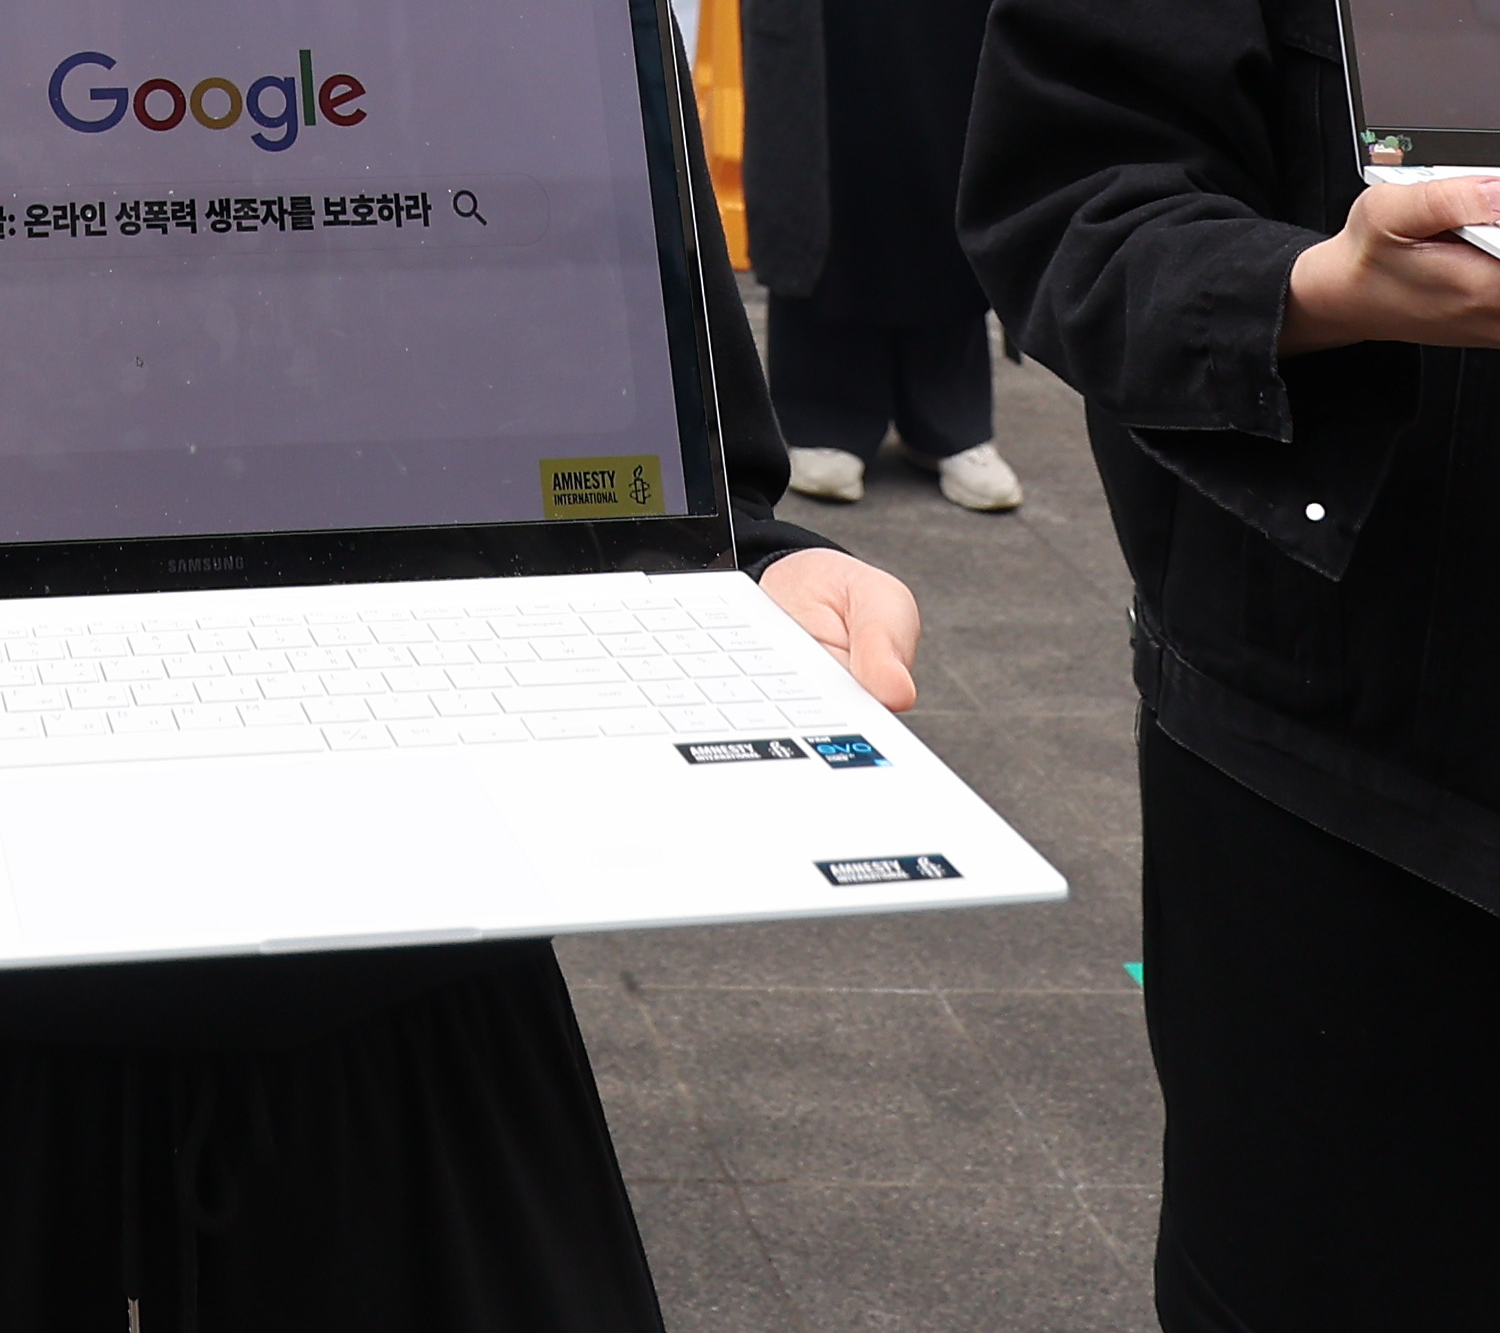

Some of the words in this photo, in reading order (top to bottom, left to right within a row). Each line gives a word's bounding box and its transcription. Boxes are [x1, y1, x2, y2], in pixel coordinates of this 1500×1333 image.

[48, 49, 368, 152] Google
[23, 201, 107, 238] 온라인
[115, 197, 198, 235] 성폭력
[204, 195, 315, 233] 생존자를
[322, 192, 432, 228] 보호하라
[553, 470, 616, 491] AMNESTY
[553, 492, 619, 506] INTERNATIONAL
[168, 555, 245, 574] SAMSUNG
[689, 743, 755, 757] AMNESTY
